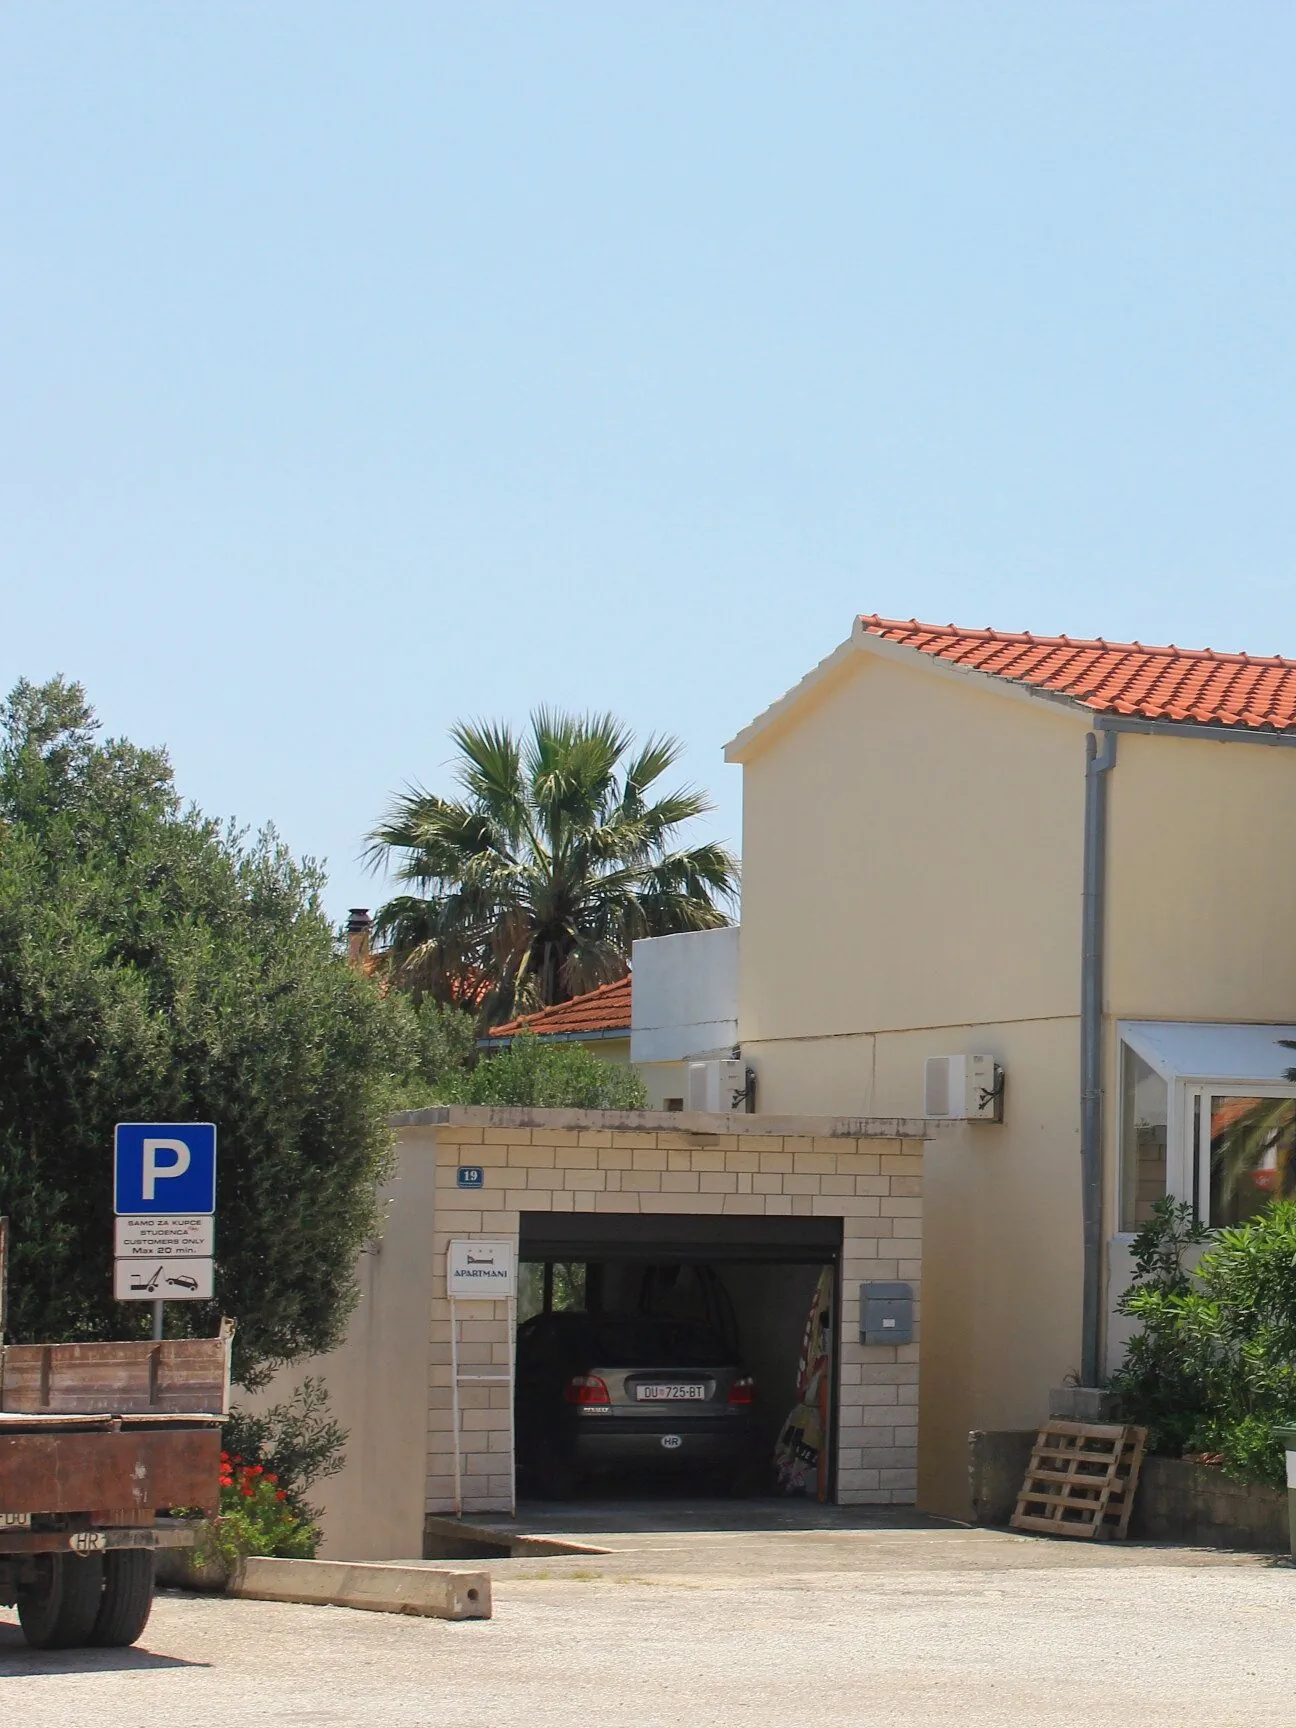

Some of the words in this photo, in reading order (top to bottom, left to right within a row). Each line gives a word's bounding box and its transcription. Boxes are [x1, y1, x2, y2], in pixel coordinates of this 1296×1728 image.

[141, 1138, 191, 1200] P
[464, 1170, 478, 1181] 19
[455, 1269, 507, 1278] APARTMANI
[644, 1387, 658, 1398] DU
[666, 1386, 702, 1398] 725-BT
[664, 1437, 679, 1446] HR
[77, 1533, 99, 1549] HR
